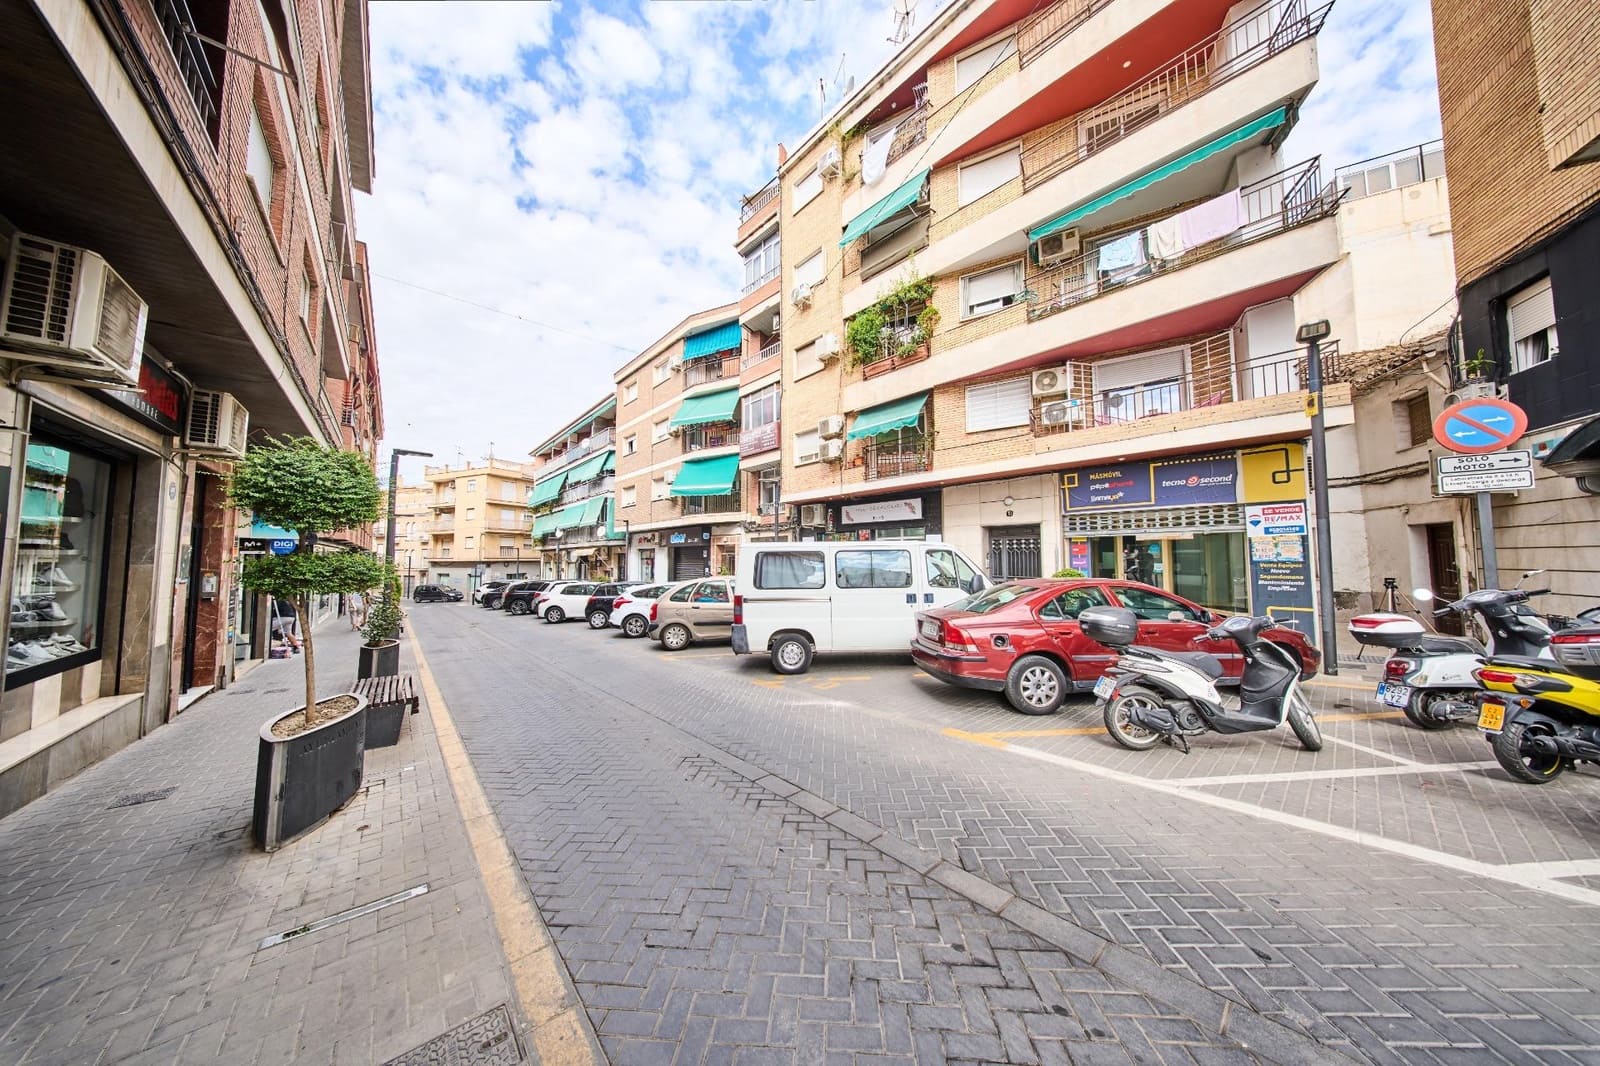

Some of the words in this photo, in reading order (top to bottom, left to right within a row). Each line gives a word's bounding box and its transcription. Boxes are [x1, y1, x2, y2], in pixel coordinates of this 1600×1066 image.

[1458, 456, 1488, 464] SOLO
[1454, 462, 1494, 471] MOTOS
[1200, 474, 1232, 484] second
[1386, 684, 1408, 696] 6292
